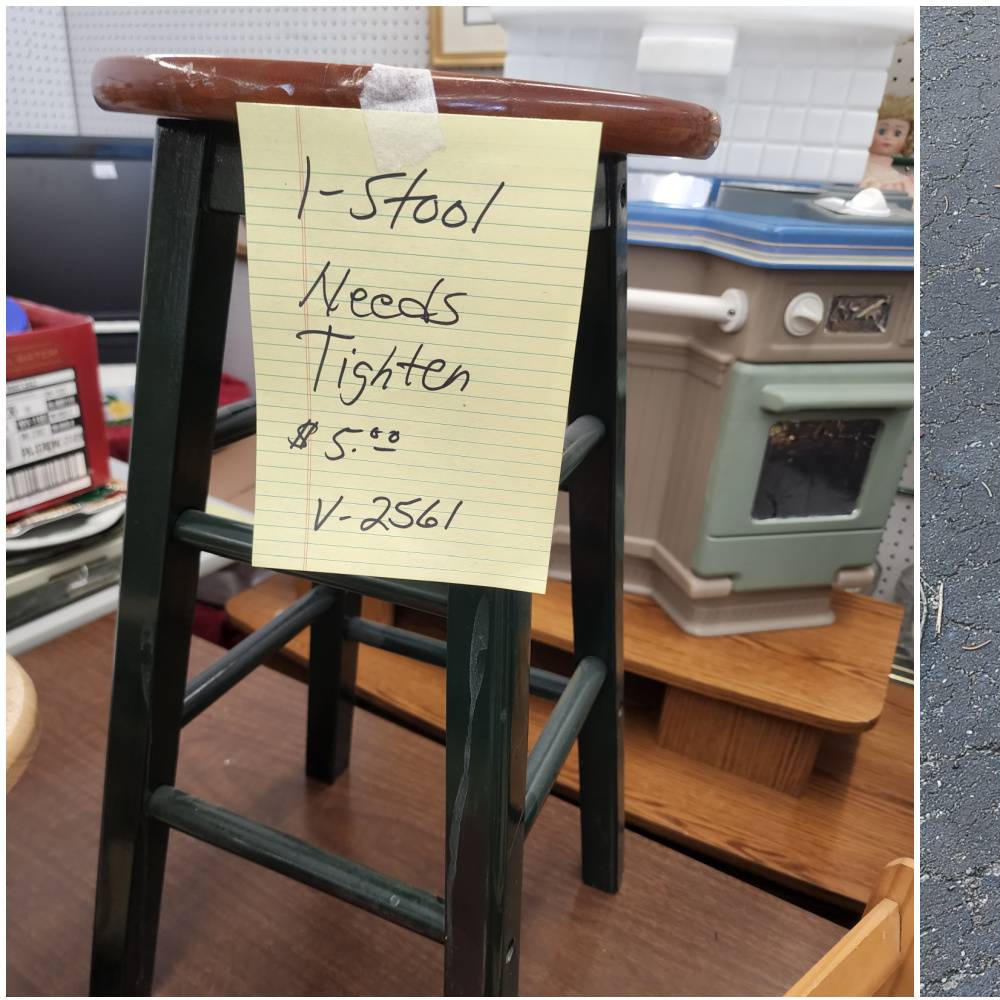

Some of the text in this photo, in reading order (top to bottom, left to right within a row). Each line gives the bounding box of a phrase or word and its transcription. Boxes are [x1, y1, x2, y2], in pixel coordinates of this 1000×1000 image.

[299, 261, 467, 326] Needs
[295, 325, 470, 406] Tighten
[313, 495, 463, 533] V-2561
